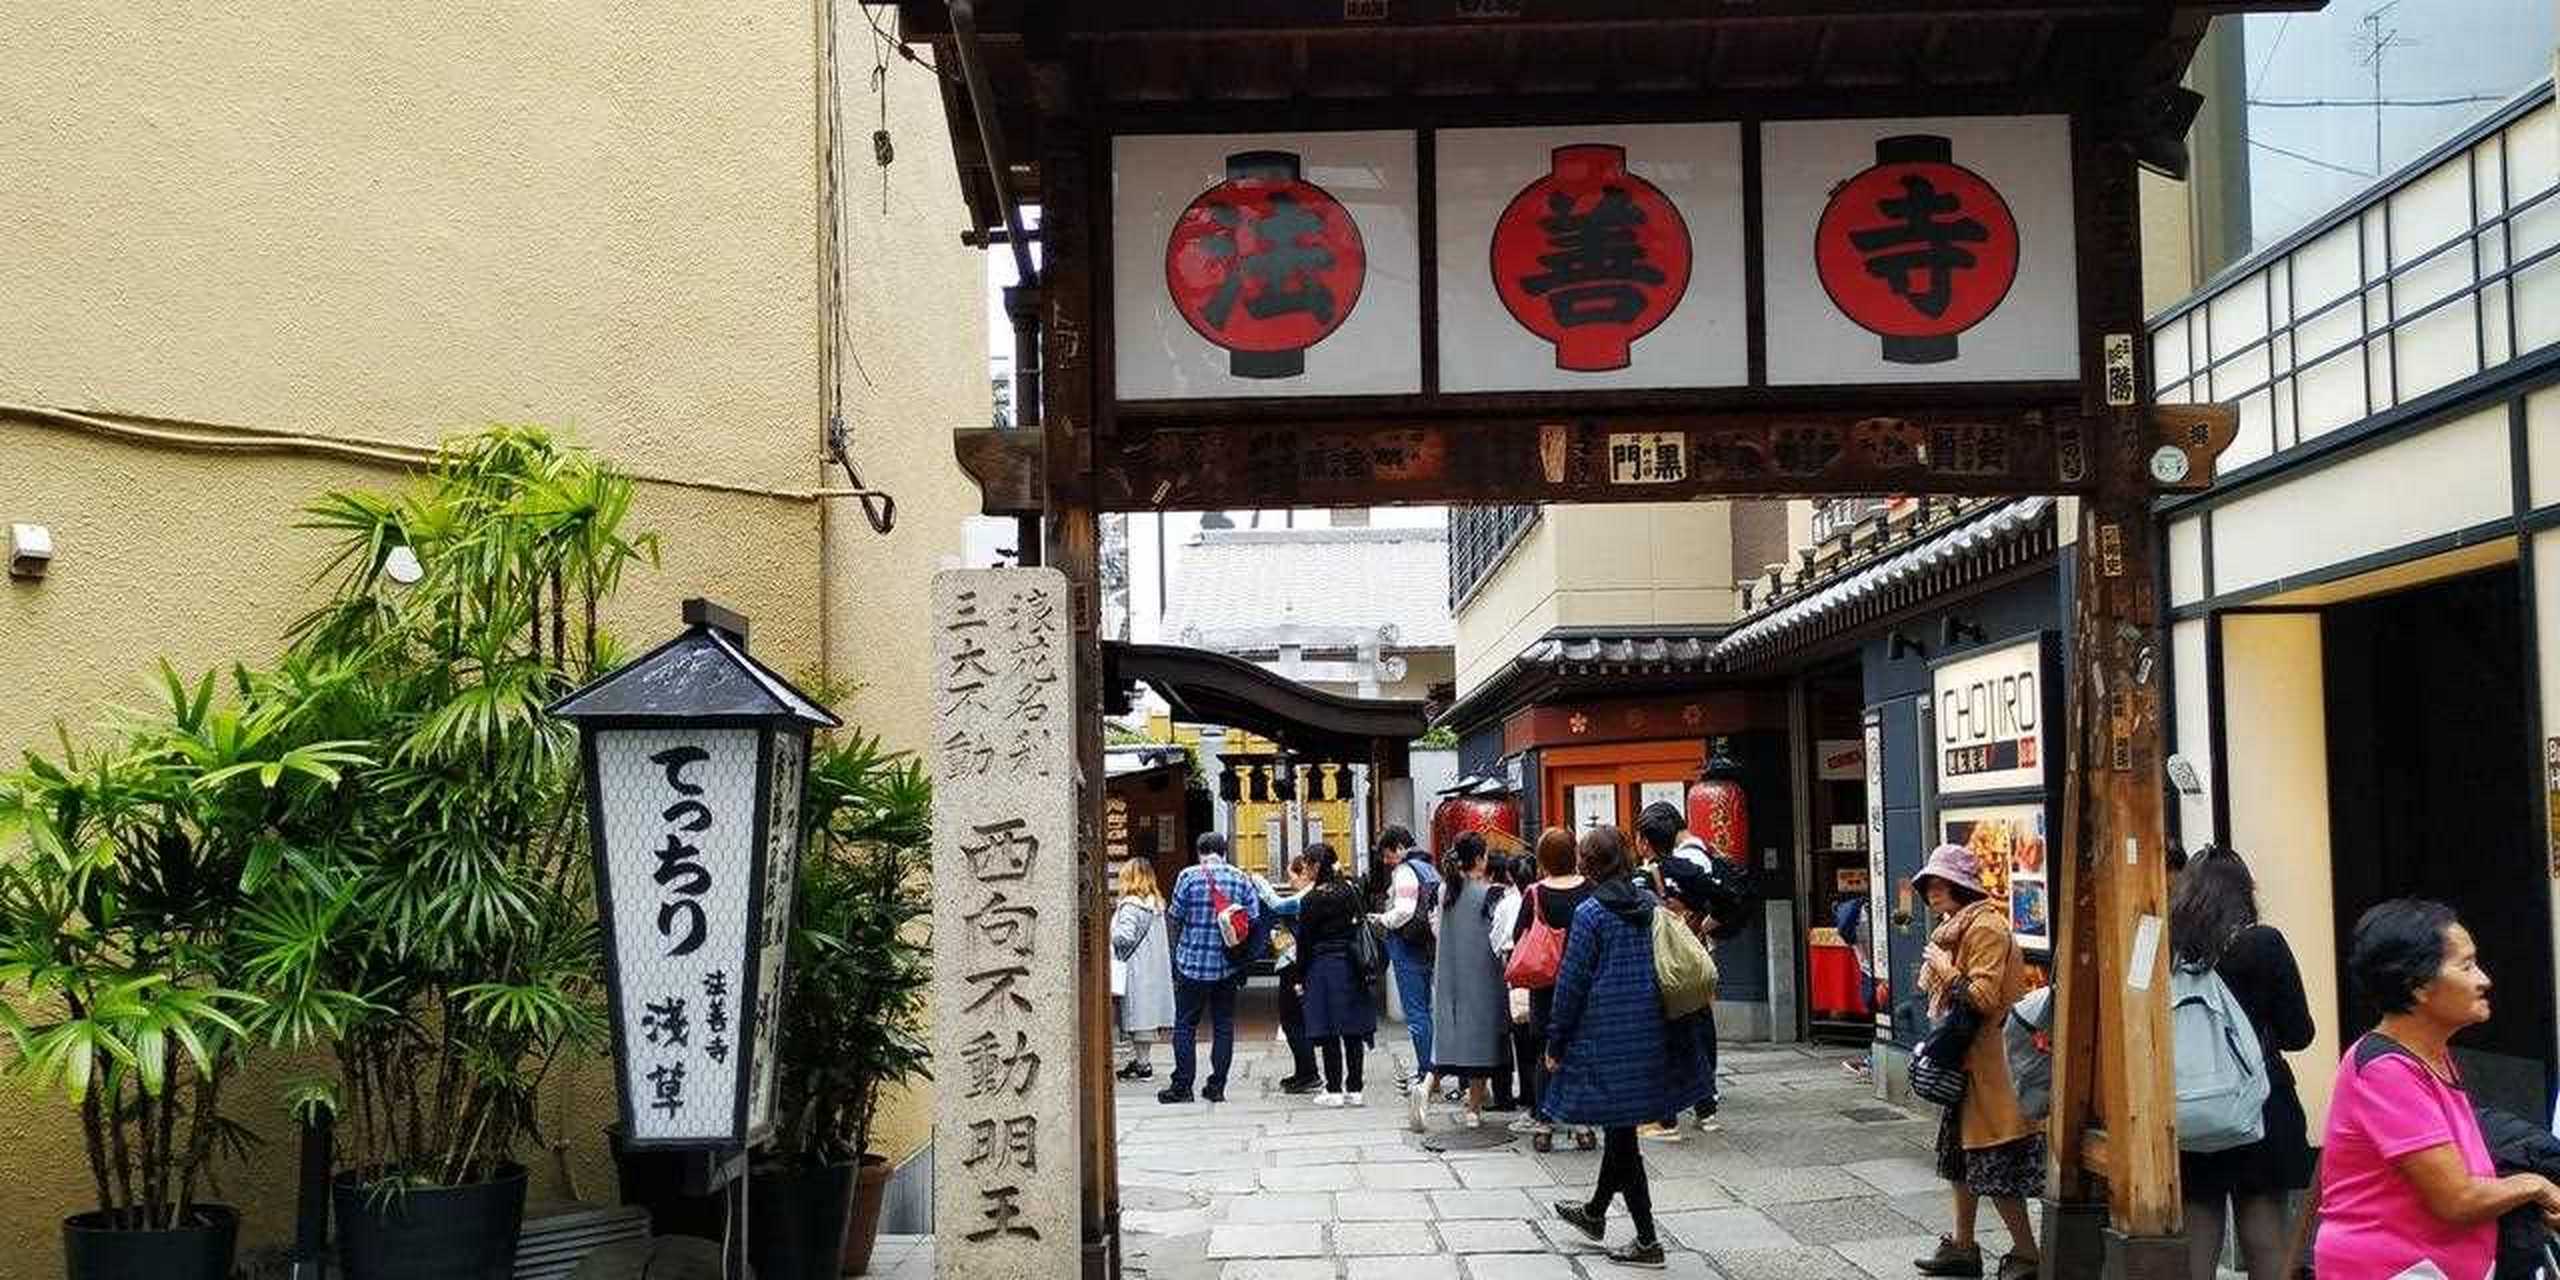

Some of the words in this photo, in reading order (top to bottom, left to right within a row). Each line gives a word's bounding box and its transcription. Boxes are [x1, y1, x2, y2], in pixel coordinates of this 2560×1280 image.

[1200, 191, 1336, 330] 法
[1520, 187, 1665, 327] 善
[1850, 175, 1989, 319] 寺
[944, 591, 996, 781] 三大不動
[650, 746, 713, 957] てっちり
[702, 970, 729, 1063] 法善寺
[960, 817, 1041, 1242] 西向不動明王
